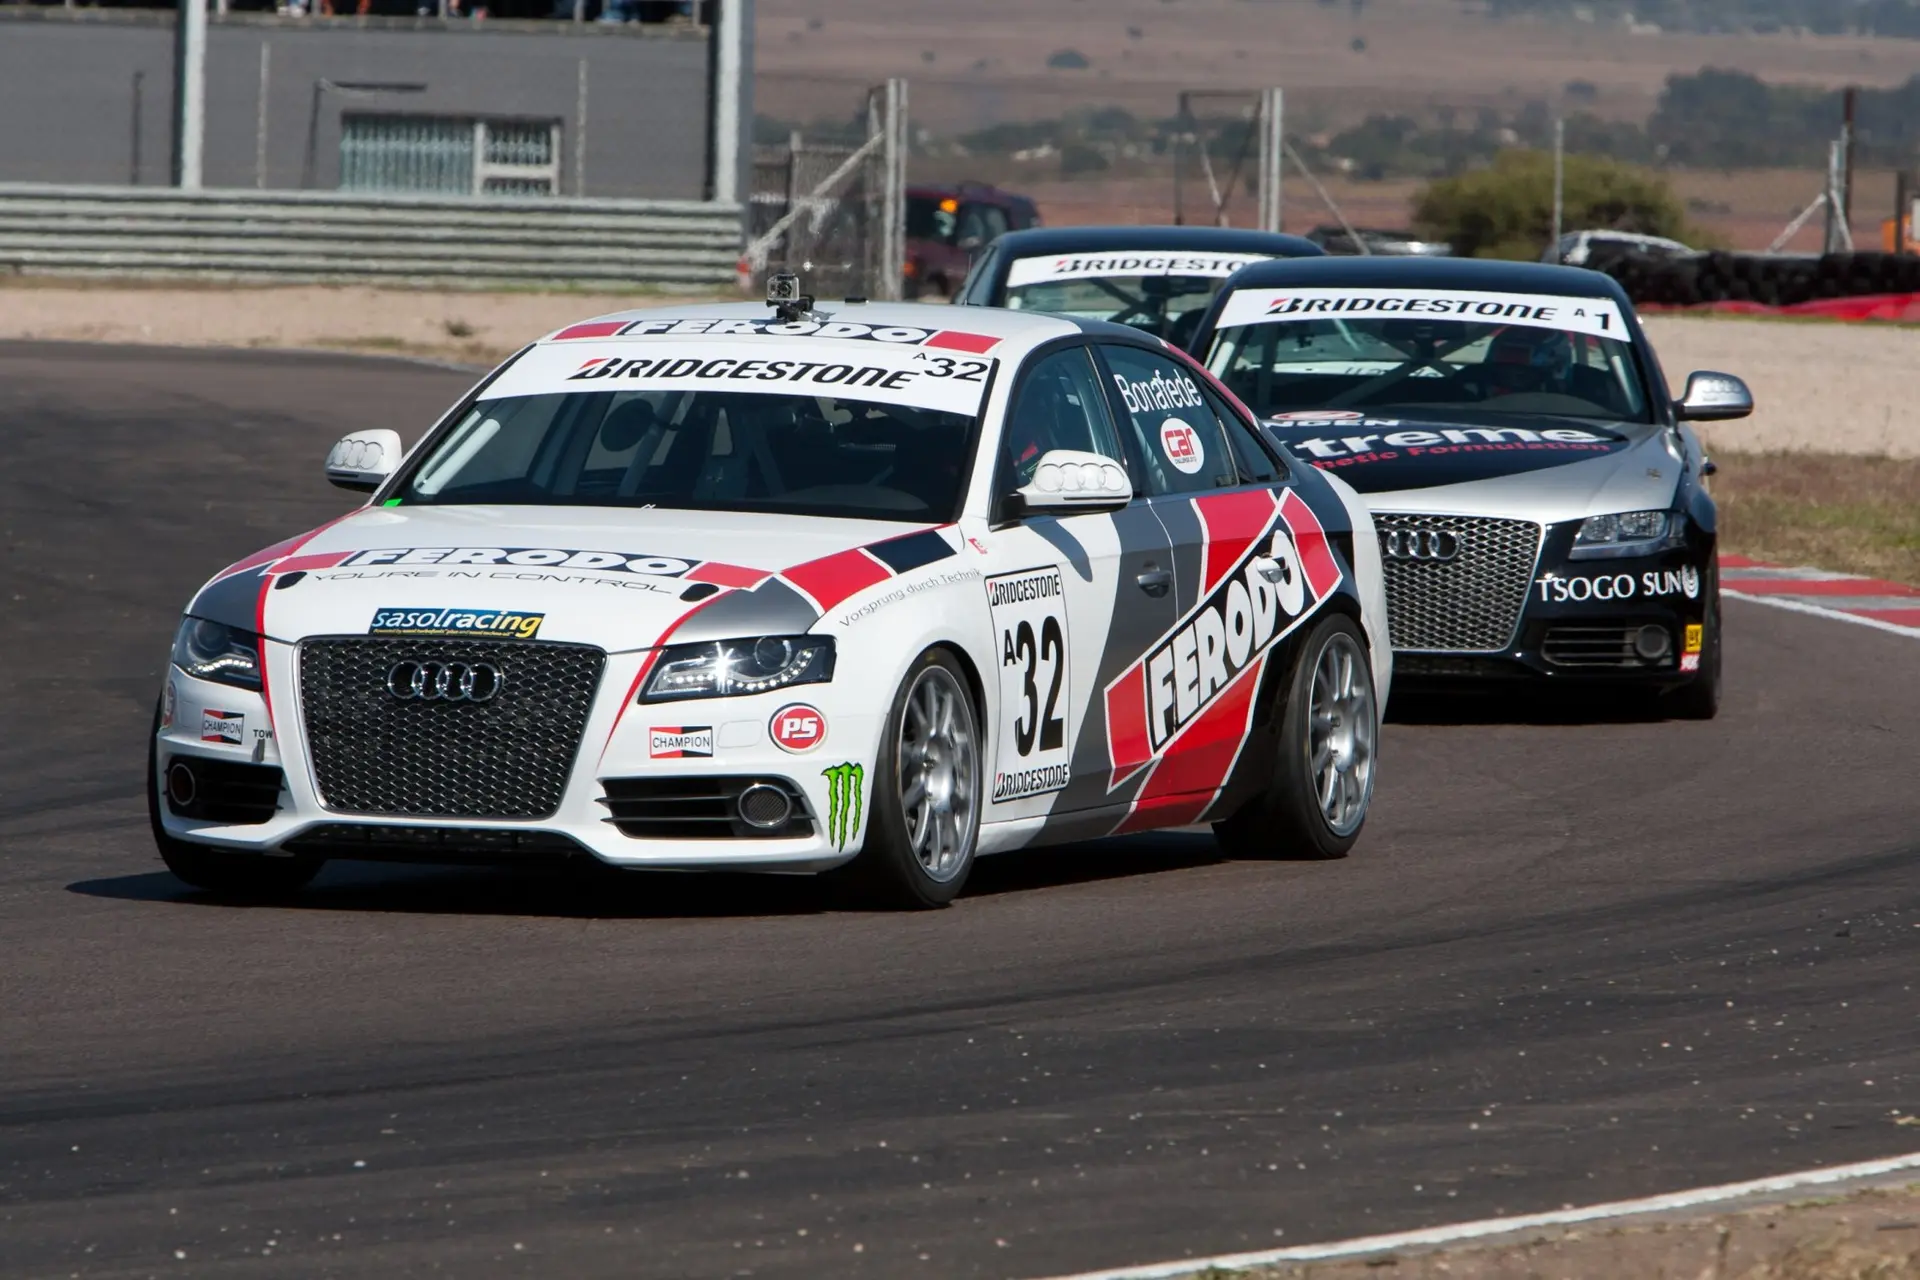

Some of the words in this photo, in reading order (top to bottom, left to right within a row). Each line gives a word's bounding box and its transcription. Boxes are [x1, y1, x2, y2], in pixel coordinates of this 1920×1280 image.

[1265, 297, 1557, 321] BRIDGESTONE
[1594, 312, 1610, 330] 1
[624, 319, 927, 343] FERODO
[566, 357, 921, 389] BRIDGESTONE
[1113, 369, 1202, 413] Bonafede
[1164, 428, 1195, 457] car
[1281, 427, 1612, 458] treme
[1407, 444, 1612, 457] Formulation
[346, 548, 690, 576] FERODO
[484, 572, 673, 594] CONTROL
[839, 588, 906, 627] Vorsprung
[906, 579, 940, 594] durch
[939, 568, 983, 583] Technik
[990, 574, 1061, 606] BRIDGESTONE
[1535, 574, 1636, 602] TSOGO
[1642, 570, 1682, 596] SUN
[372, 611, 543, 638] sasolracing
[1149, 529, 1304, 747] FERODO
[203, 720, 241, 734] CHAMPION
[252, 729, 273, 738] TOW
[781, 717, 819, 739] PS
[652, 737, 711, 749] CHAMPION
[995, 764, 1068, 798] BRIDGESTONE
